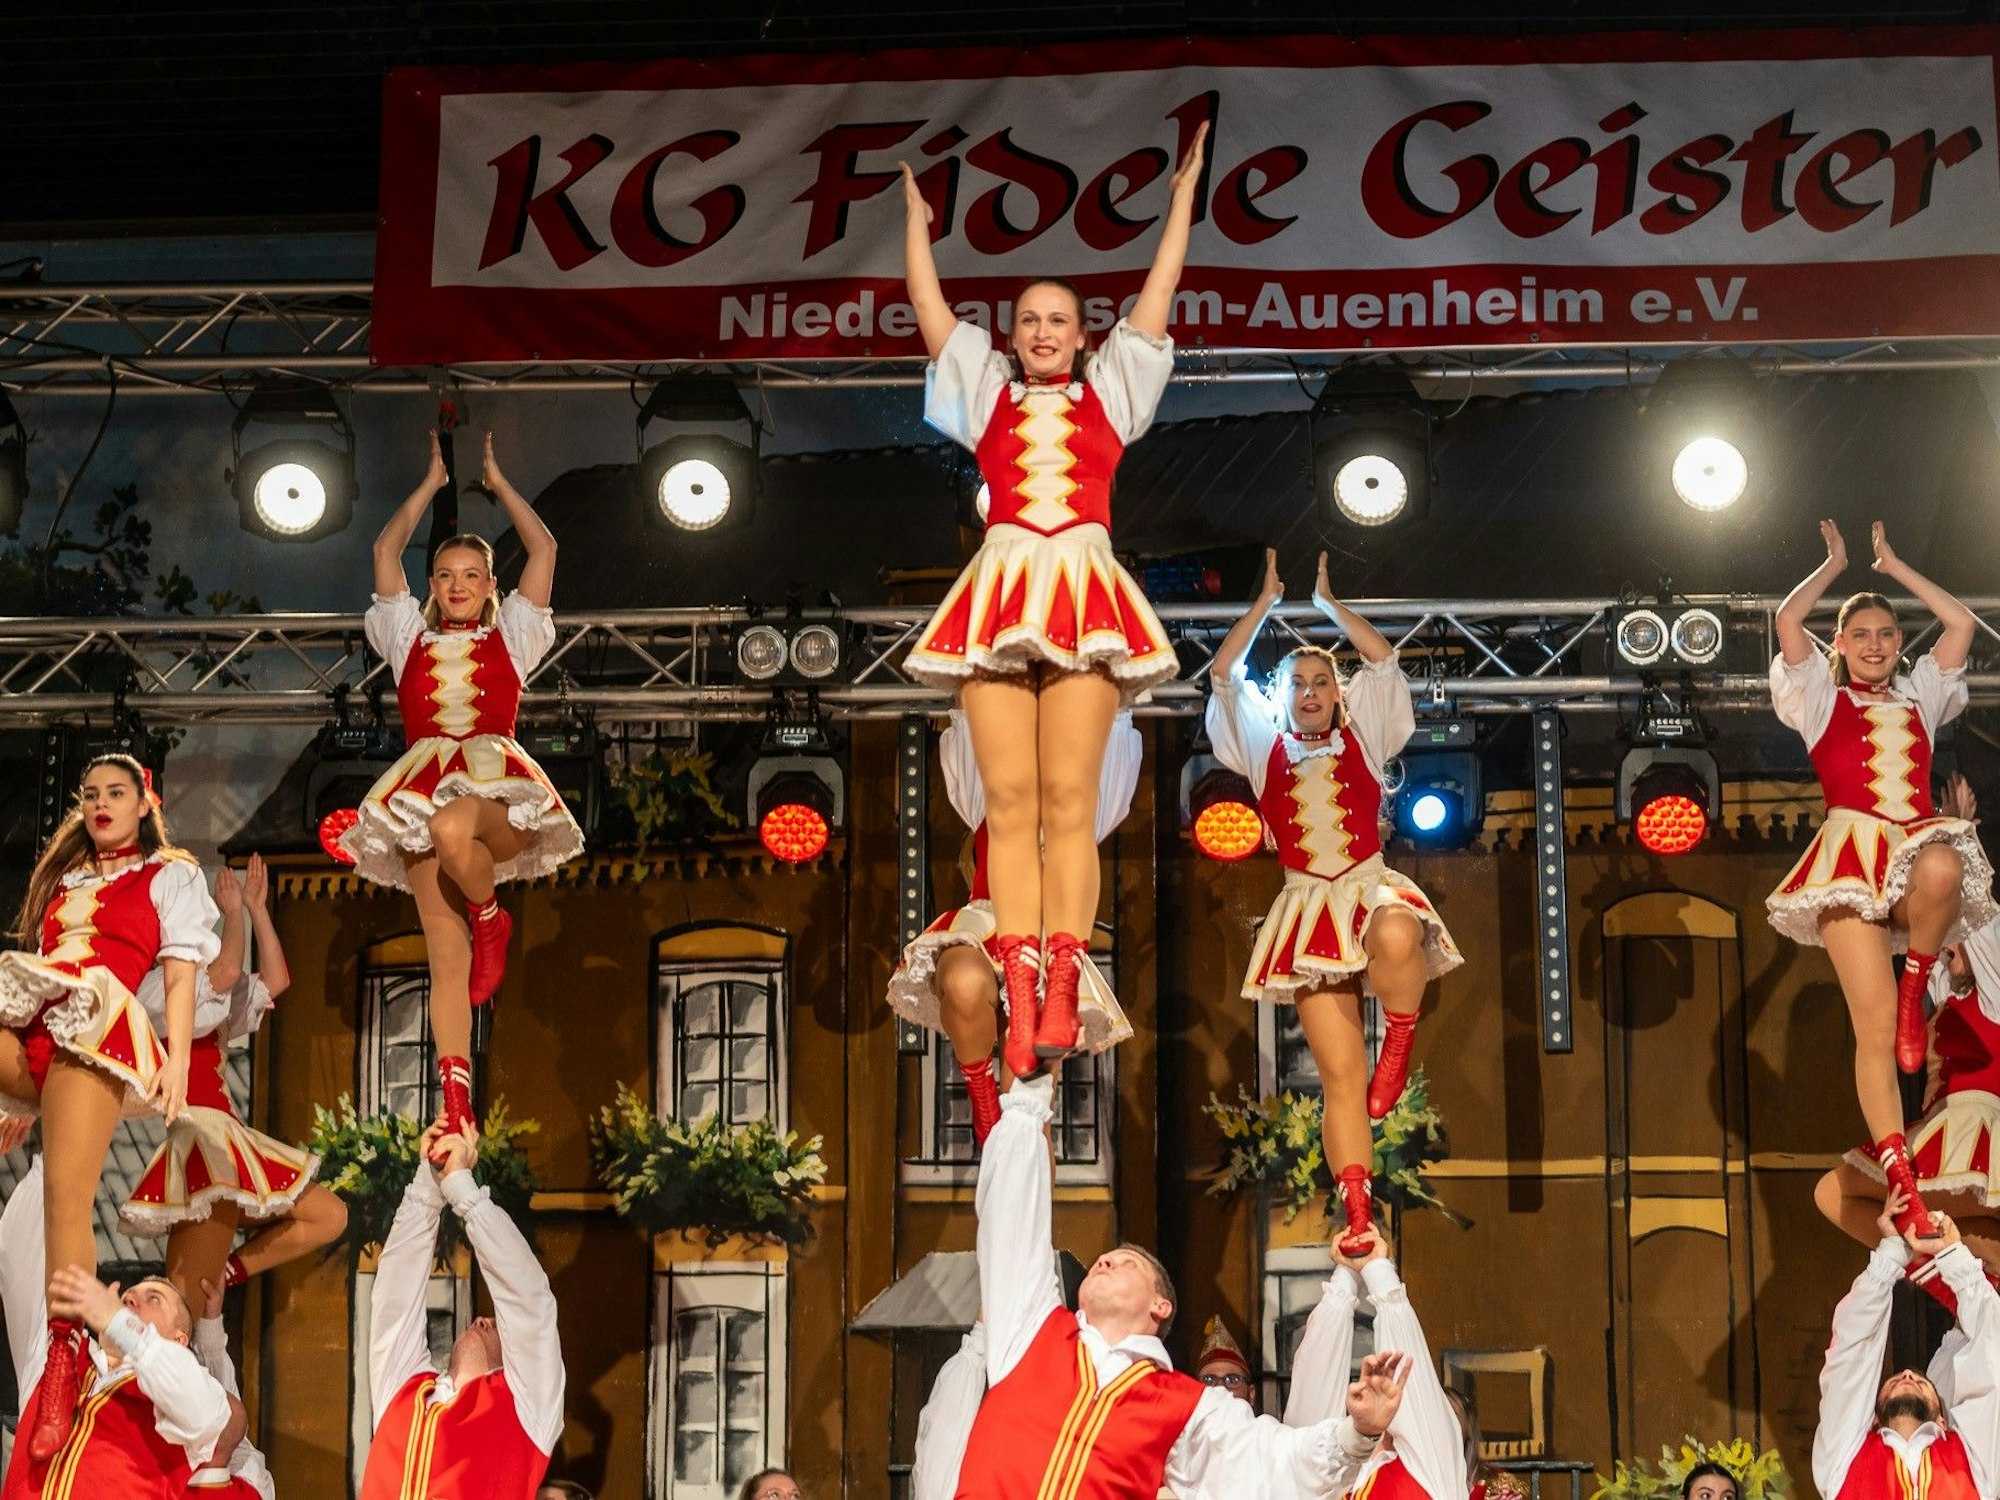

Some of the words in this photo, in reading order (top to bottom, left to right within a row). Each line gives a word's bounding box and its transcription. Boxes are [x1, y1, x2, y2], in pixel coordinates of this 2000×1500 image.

[478, 130, 746, 271] KG
[793, 89, 1308, 260] Fidele
[1361, 100, 1982, 238] Geister
[1630, 276, 1758, 323] e.V.
